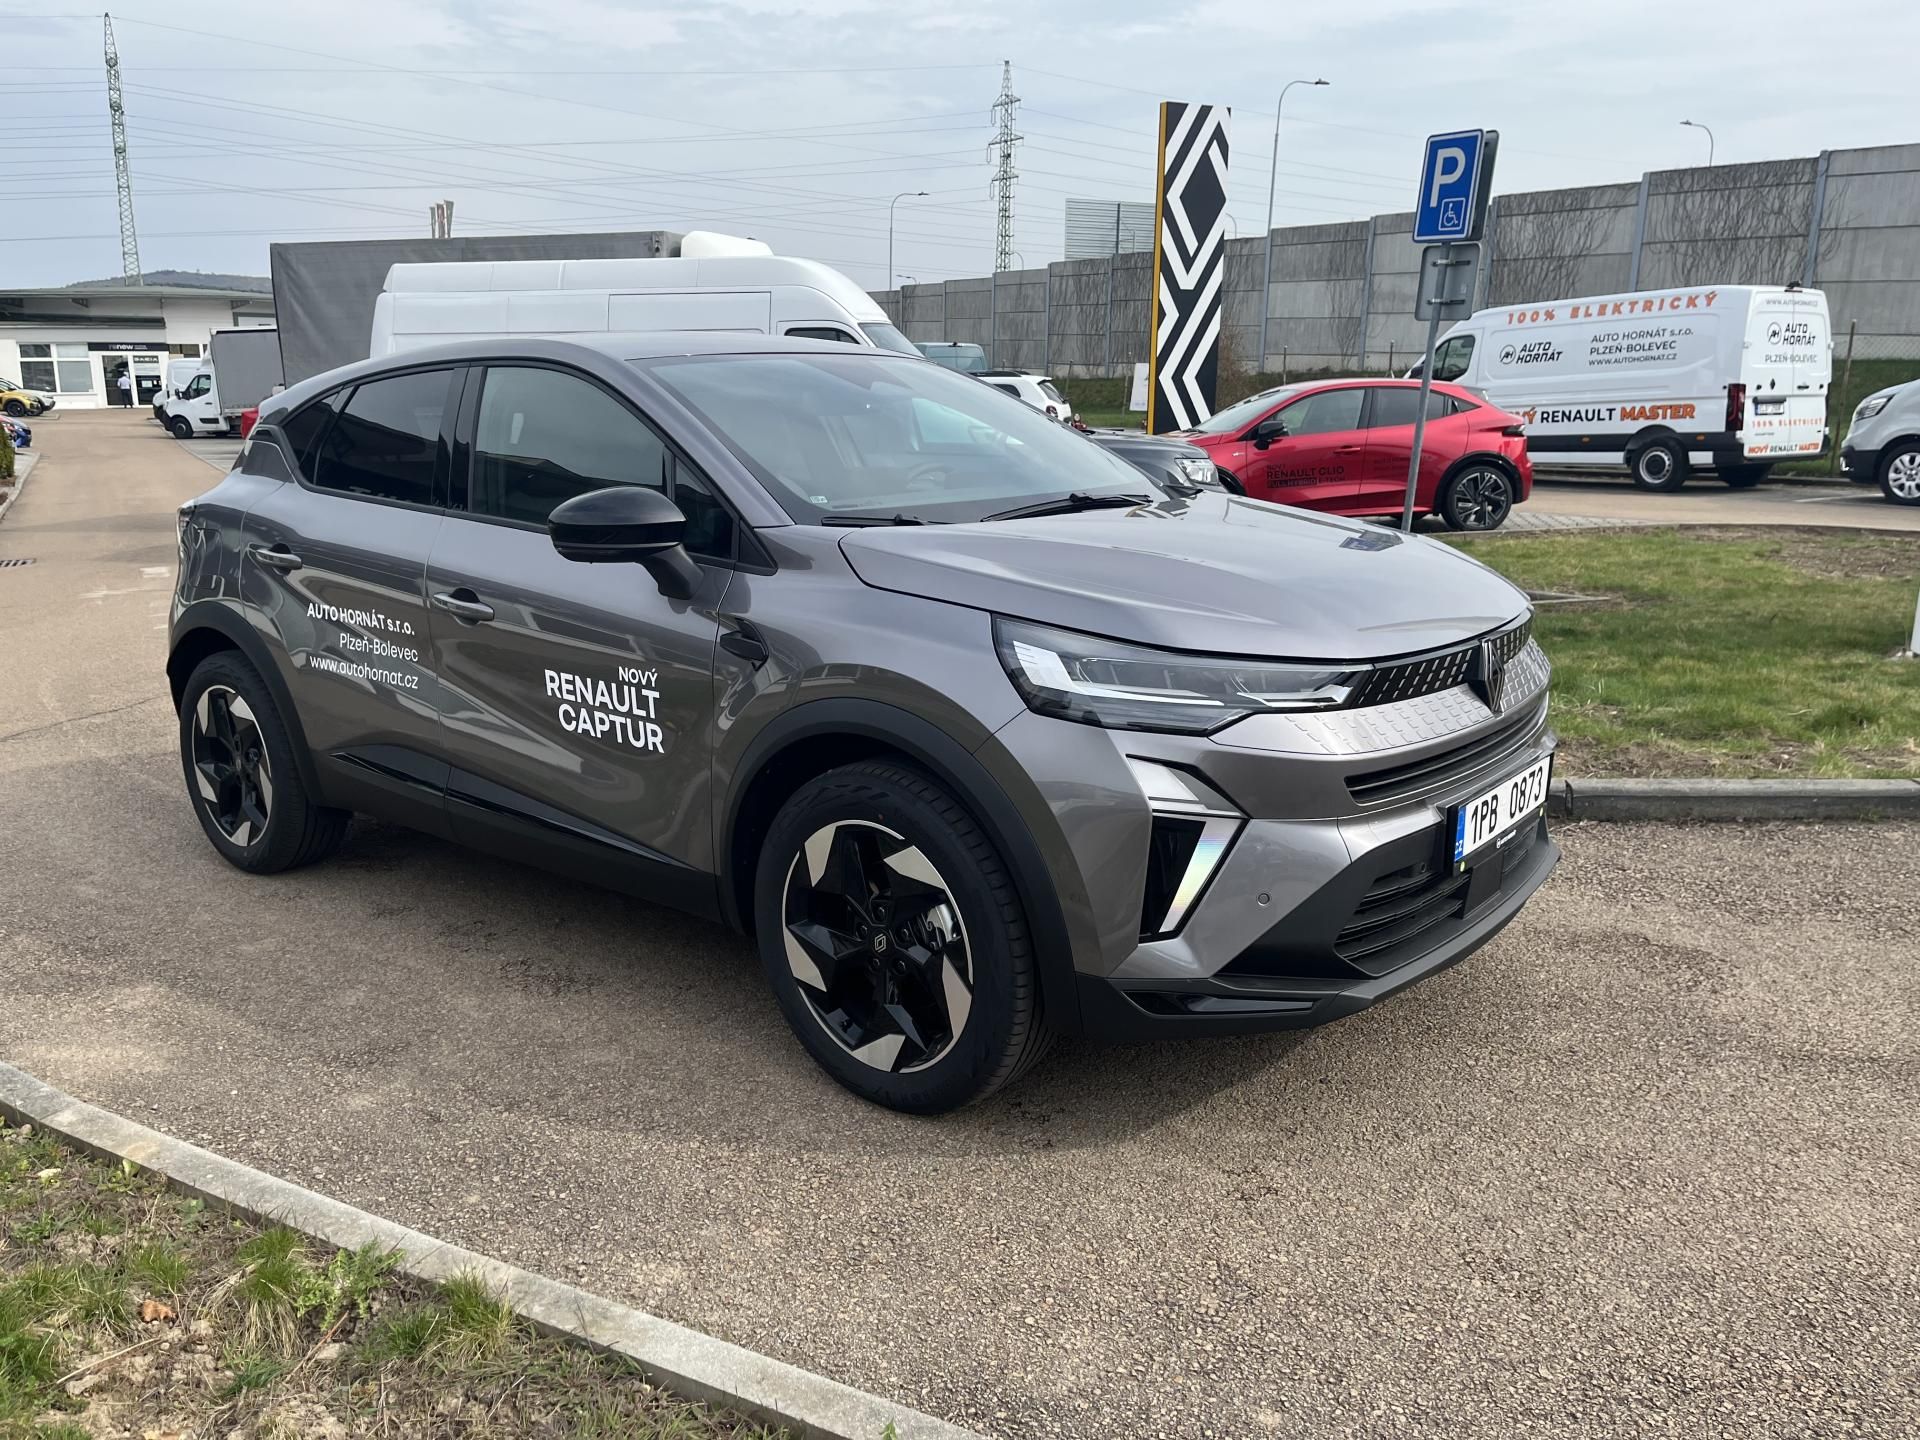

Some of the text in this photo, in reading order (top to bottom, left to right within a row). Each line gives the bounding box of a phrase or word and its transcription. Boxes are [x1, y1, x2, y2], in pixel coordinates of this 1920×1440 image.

[1430, 147, 1466, 208] P
[1508, 291, 1718, 325] 100% ELEKTRICKÝ
[1591, 326, 1694, 344] AUTO HORNÁT s.r.o.
[1784, 323, 1808, 333] AUTO
[1520, 341, 1552, 354] AUTO
[1589, 340, 1677, 356] PLZEŇ-BOLEVEC
[1782, 332, 1816, 345] HORNÁT
[1516, 348, 1563, 364] HORNÁT
[1588, 353, 1678, 366] WWW.AUTOHORNAT.CZ
[1540, 408, 1616, 424] RENAULT
[1620, 404, 1695, 421] MASTER
[1267, 466, 1344, 479] RENAULT CLIO
[307, 602, 415, 635] AUTO HORNÁT s.r.o.
[340, 633, 419, 661] Plzeň-Bolevec
[309, 656, 419, 689] www.autohornat.cz
[619, 666, 658, 687] NOVÝ
[544, 669, 660, 719] RENAULT
[558, 703, 665, 753] CAPTUR
[1471, 766, 1543, 844] 1PB 0873
